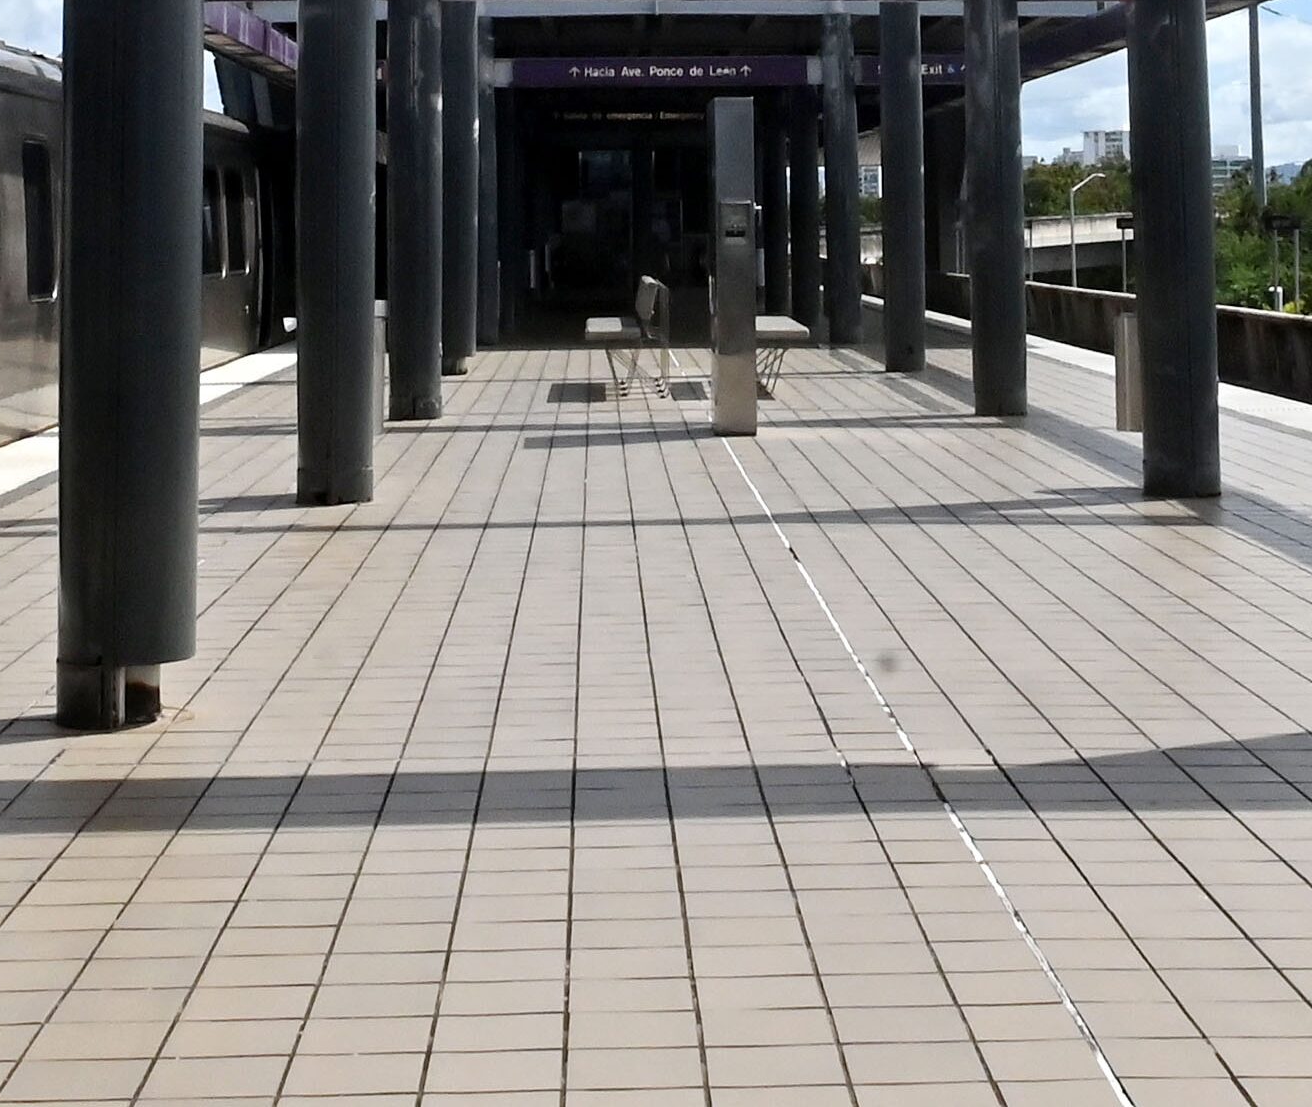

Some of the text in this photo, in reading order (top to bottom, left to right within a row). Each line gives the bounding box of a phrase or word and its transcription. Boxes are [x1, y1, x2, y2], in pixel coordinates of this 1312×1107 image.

[584, 66, 615, 78] Hacia
[649, 65, 684, 77] Ponce
[689, 65, 704, 77] de
